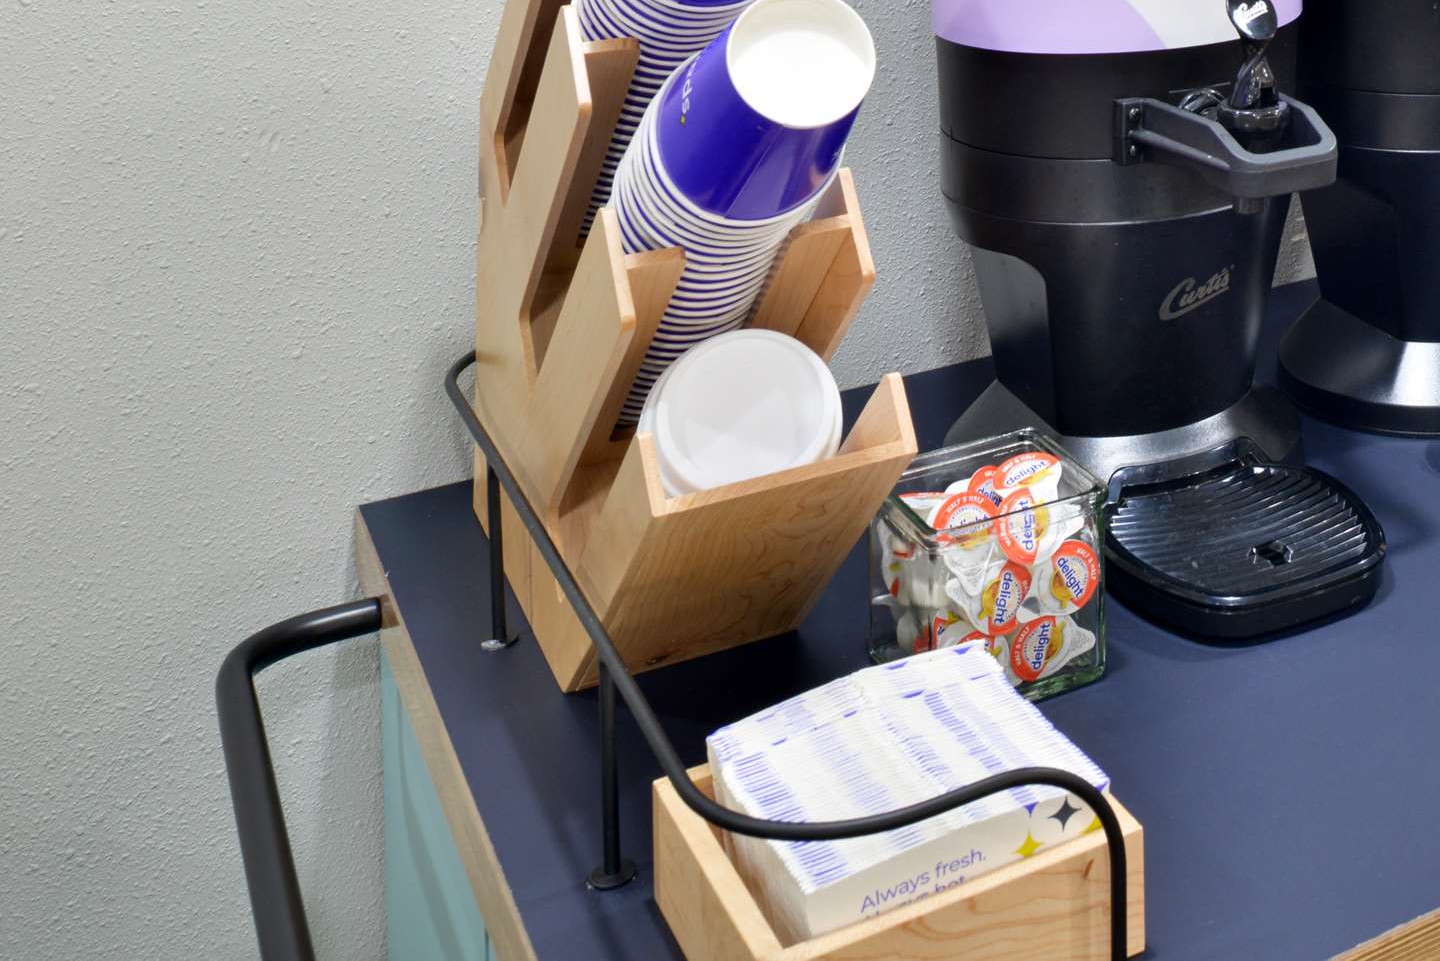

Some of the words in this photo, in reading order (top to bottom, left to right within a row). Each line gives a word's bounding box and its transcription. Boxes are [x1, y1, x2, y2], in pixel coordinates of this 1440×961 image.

[993, 571, 1013, 625] delight
[1057, 557, 1083, 599] delight
[1031, 622, 1050, 671] delight
[860, 871, 930, 913] Always
[935, 848, 987, 878] fresh.
